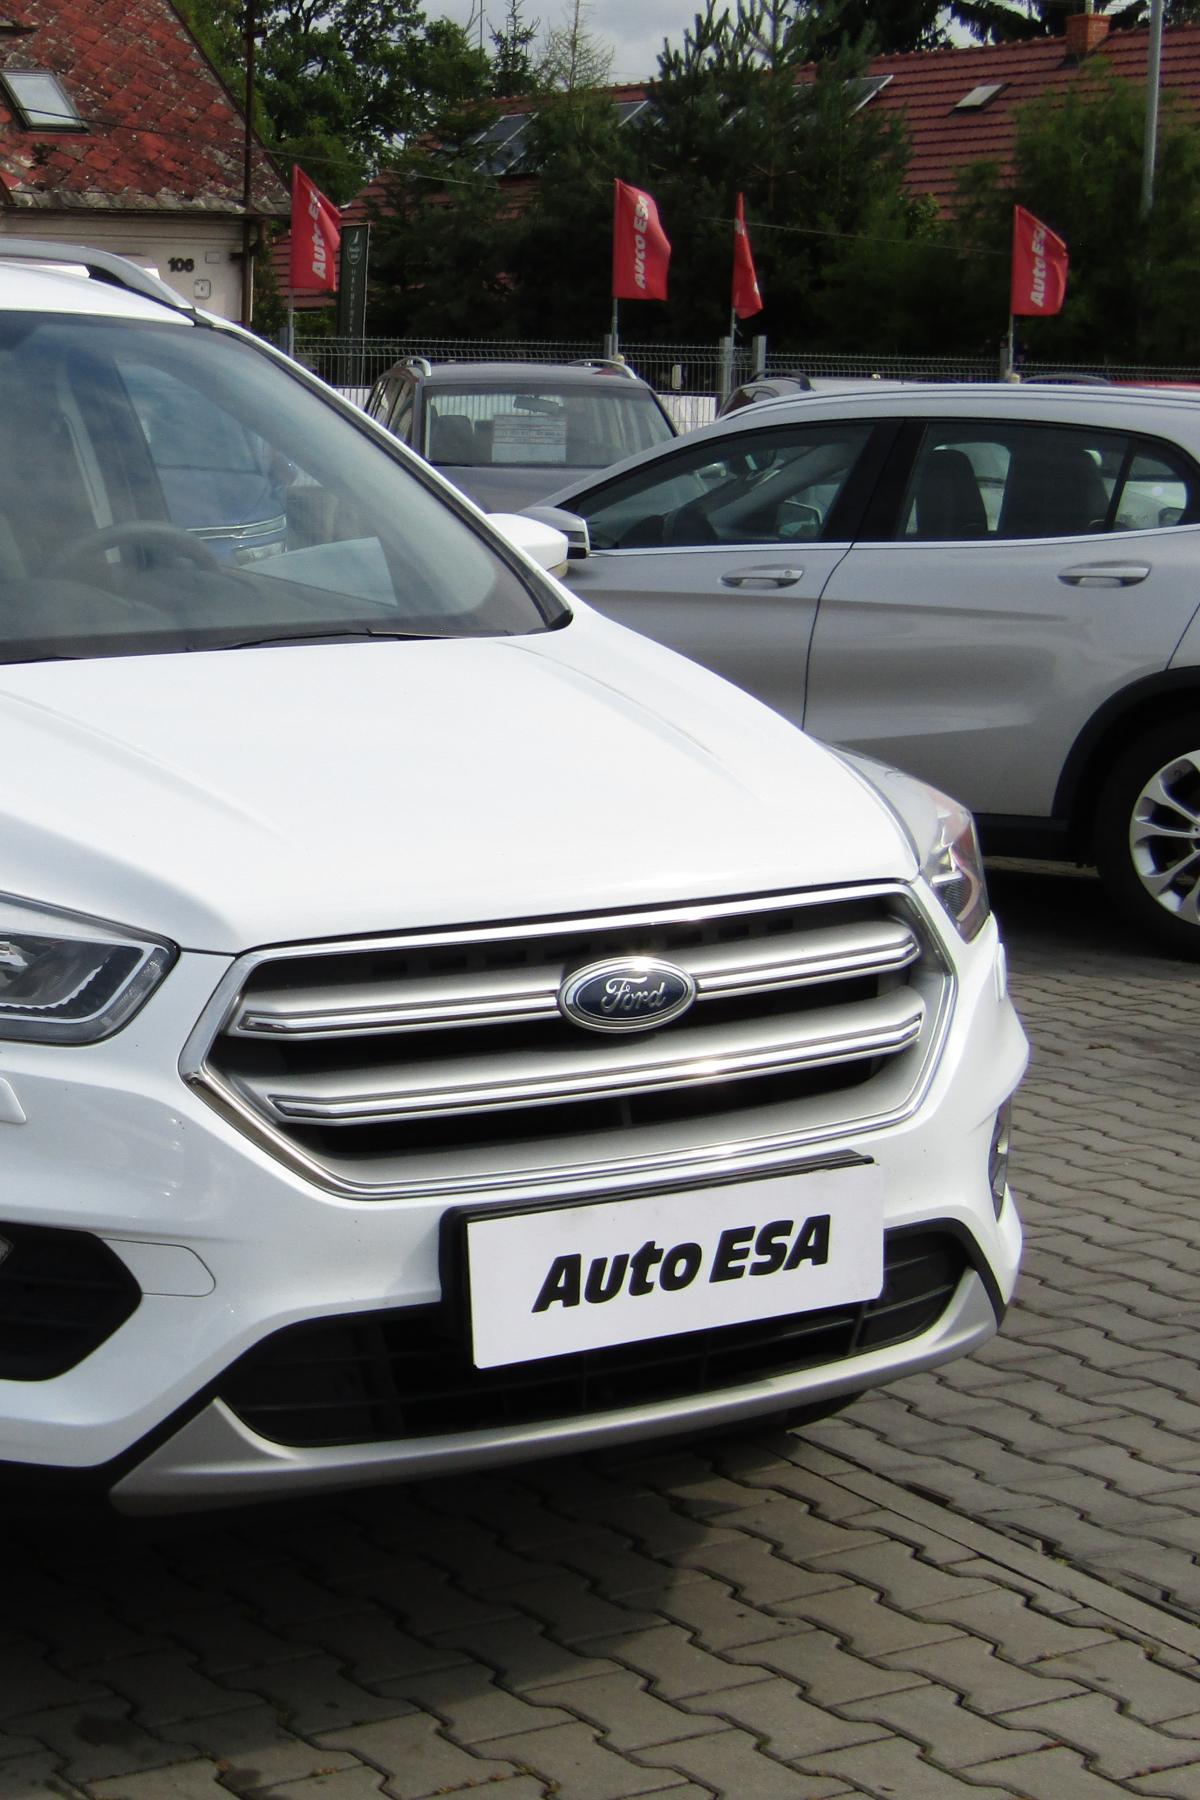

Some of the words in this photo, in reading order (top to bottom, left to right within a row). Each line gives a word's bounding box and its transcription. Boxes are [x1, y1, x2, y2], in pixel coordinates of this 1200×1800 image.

[601, 976, 666, 1013] Ford
[531, 1240, 702, 1314] Auto
[709, 1213, 831, 1283] ESA
